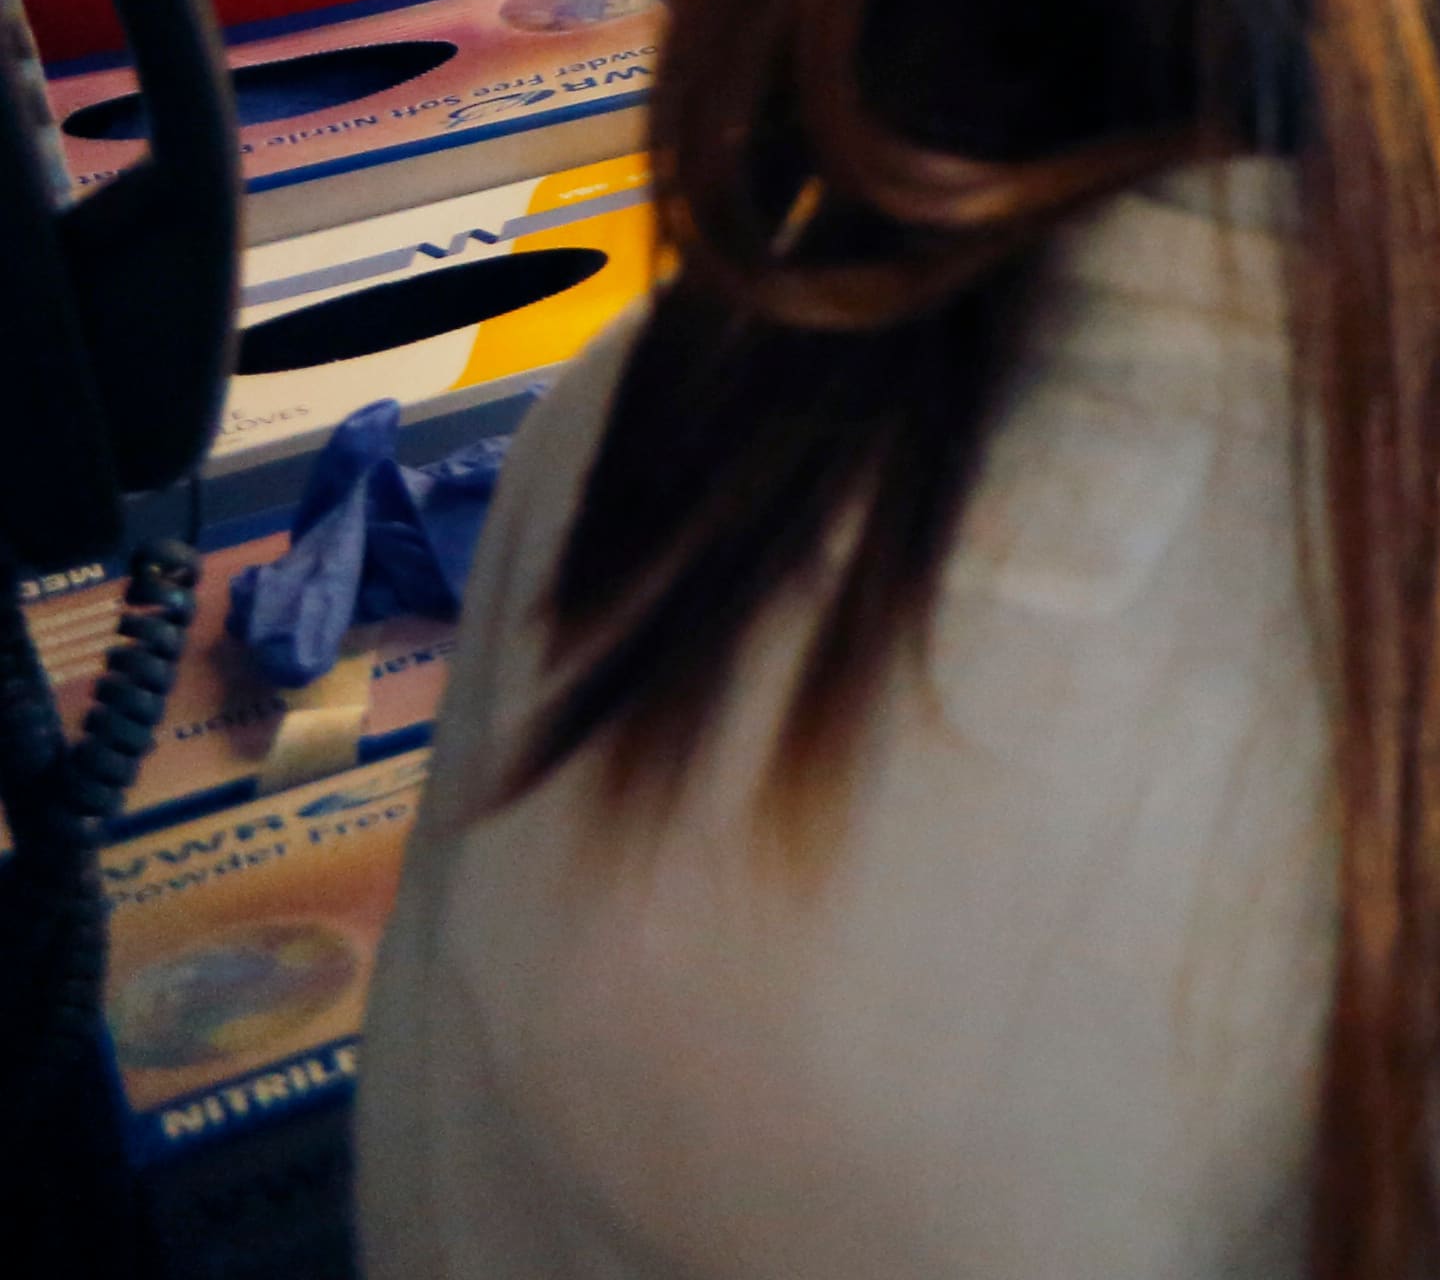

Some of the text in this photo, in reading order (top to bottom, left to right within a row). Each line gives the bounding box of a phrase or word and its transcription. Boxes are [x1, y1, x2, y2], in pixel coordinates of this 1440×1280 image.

[268, 46, 658, 146] owder Free Soft Nitrile
[561, 66, 653, 93] WR
